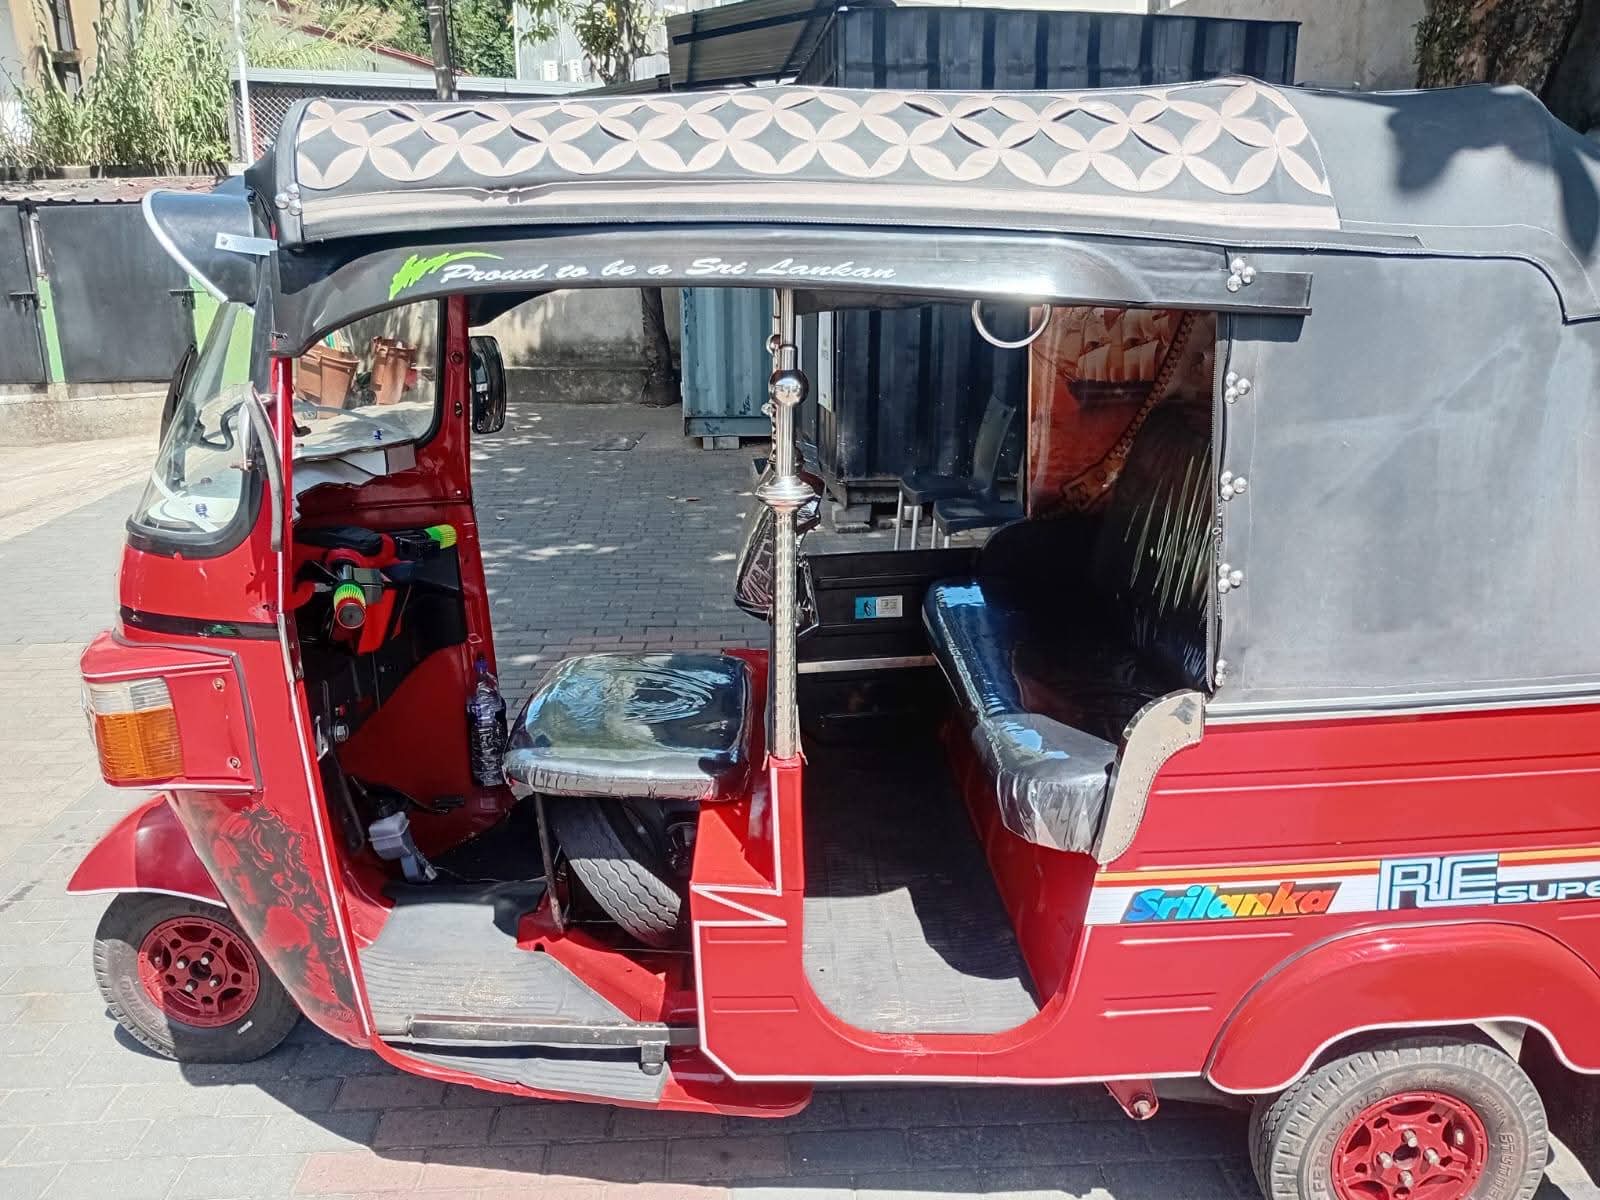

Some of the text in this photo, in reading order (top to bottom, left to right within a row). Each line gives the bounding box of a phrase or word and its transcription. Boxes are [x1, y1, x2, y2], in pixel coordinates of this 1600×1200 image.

[440, 257, 896, 283] Proud to be a Sri Lankan
[1125, 881, 1336, 922] Srilanka
